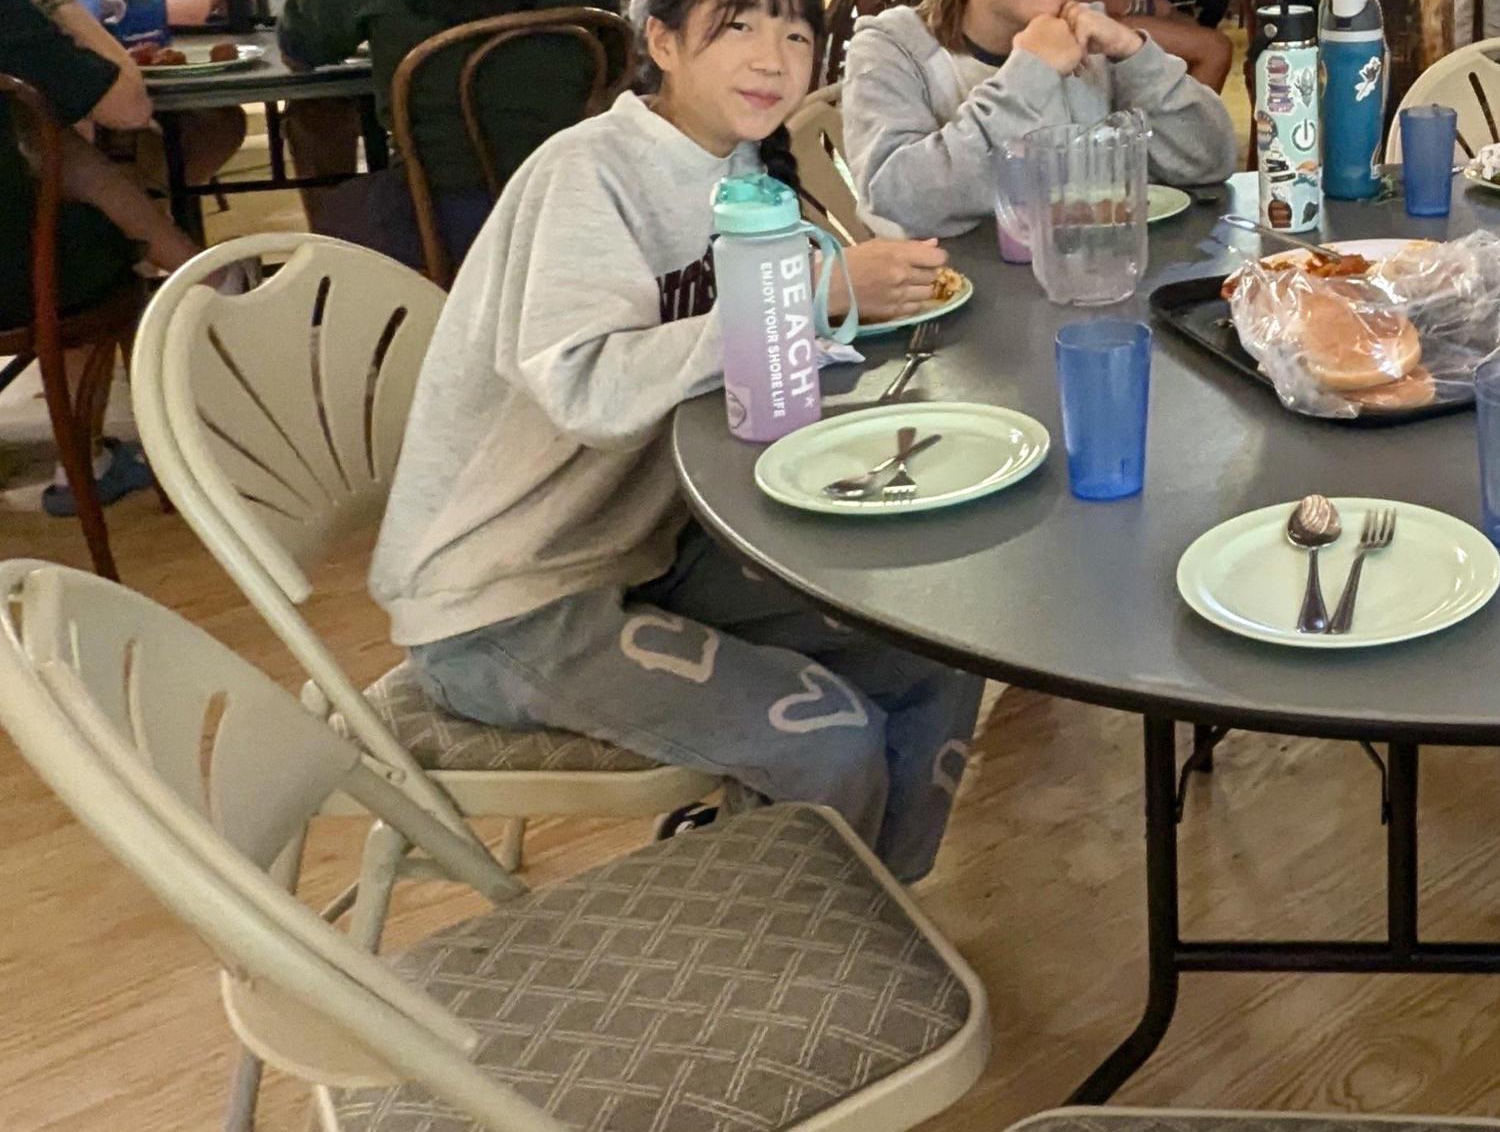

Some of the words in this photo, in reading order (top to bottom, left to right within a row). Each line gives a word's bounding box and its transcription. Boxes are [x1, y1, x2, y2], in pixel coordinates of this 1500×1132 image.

[760, 262, 777, 304] ENJOY
[764, 306, 780, 345] YOUR
[780, 254, 815, 397] BEACH
[767, 345, 785, 390] SHORE
[772, 390, 787, 418] LIFE
